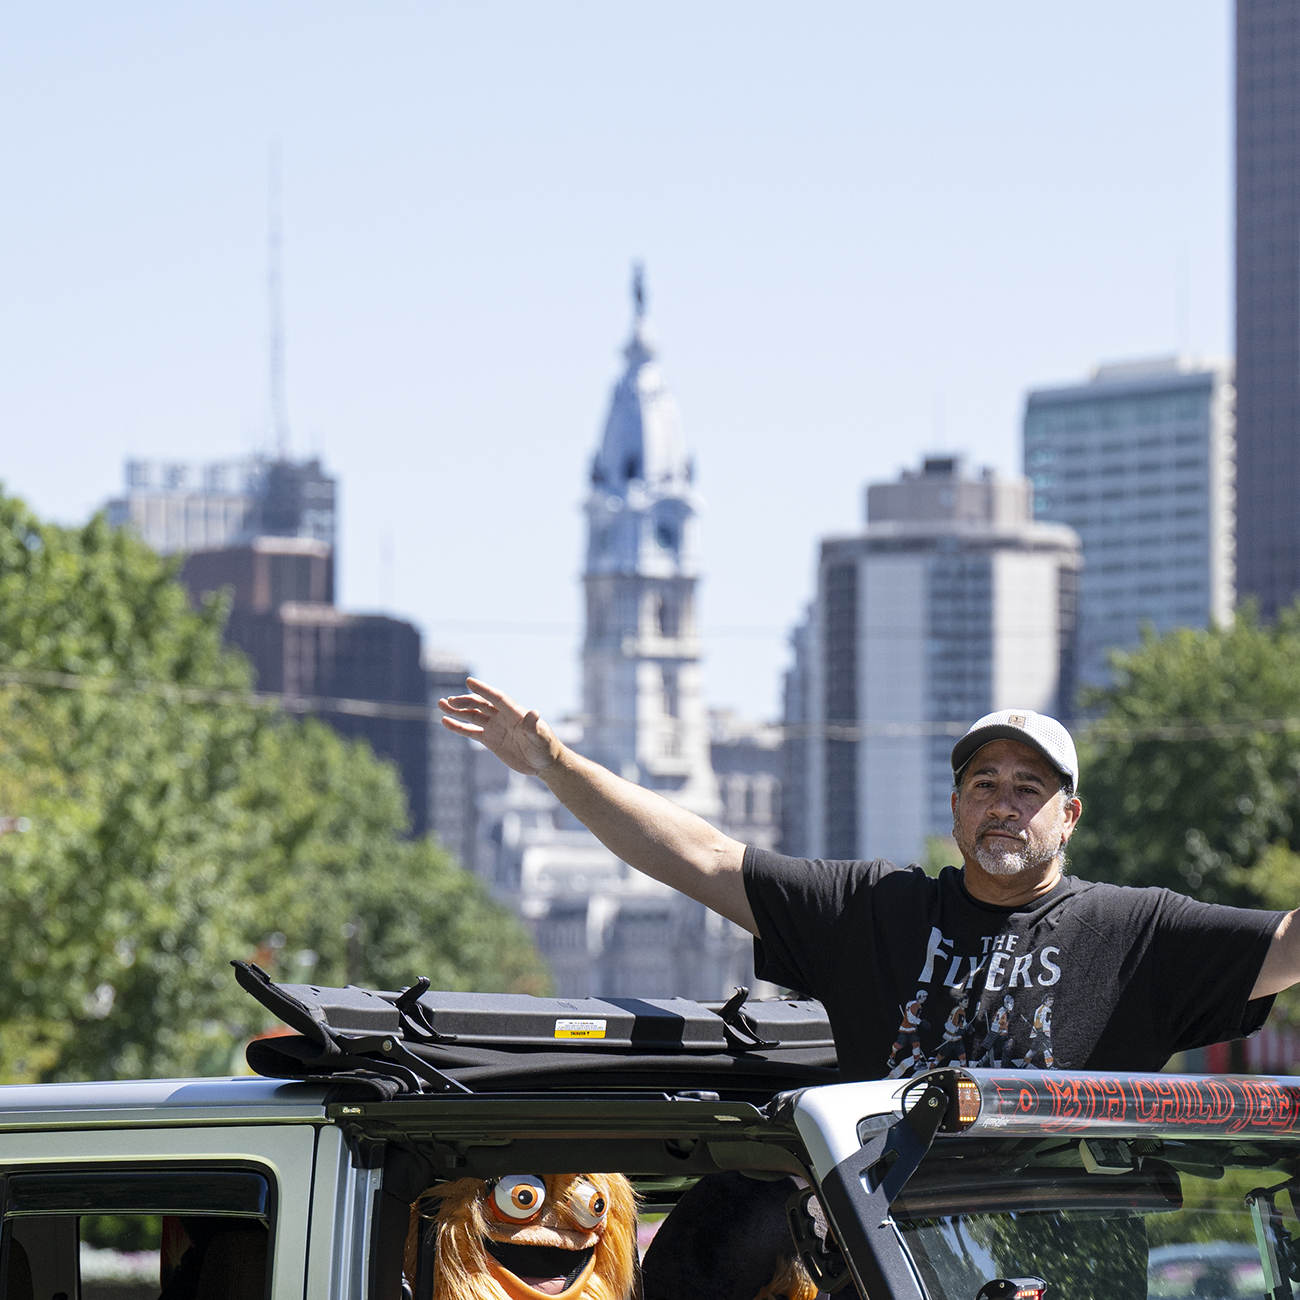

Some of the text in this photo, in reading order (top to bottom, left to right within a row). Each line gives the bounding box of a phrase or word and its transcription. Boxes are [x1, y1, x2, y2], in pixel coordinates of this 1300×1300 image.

[917, 926, 1062, 991] FLYERS
[981, 934, 1019, 954] THE
[1128, 1077, 1236, 1125] CHILD
